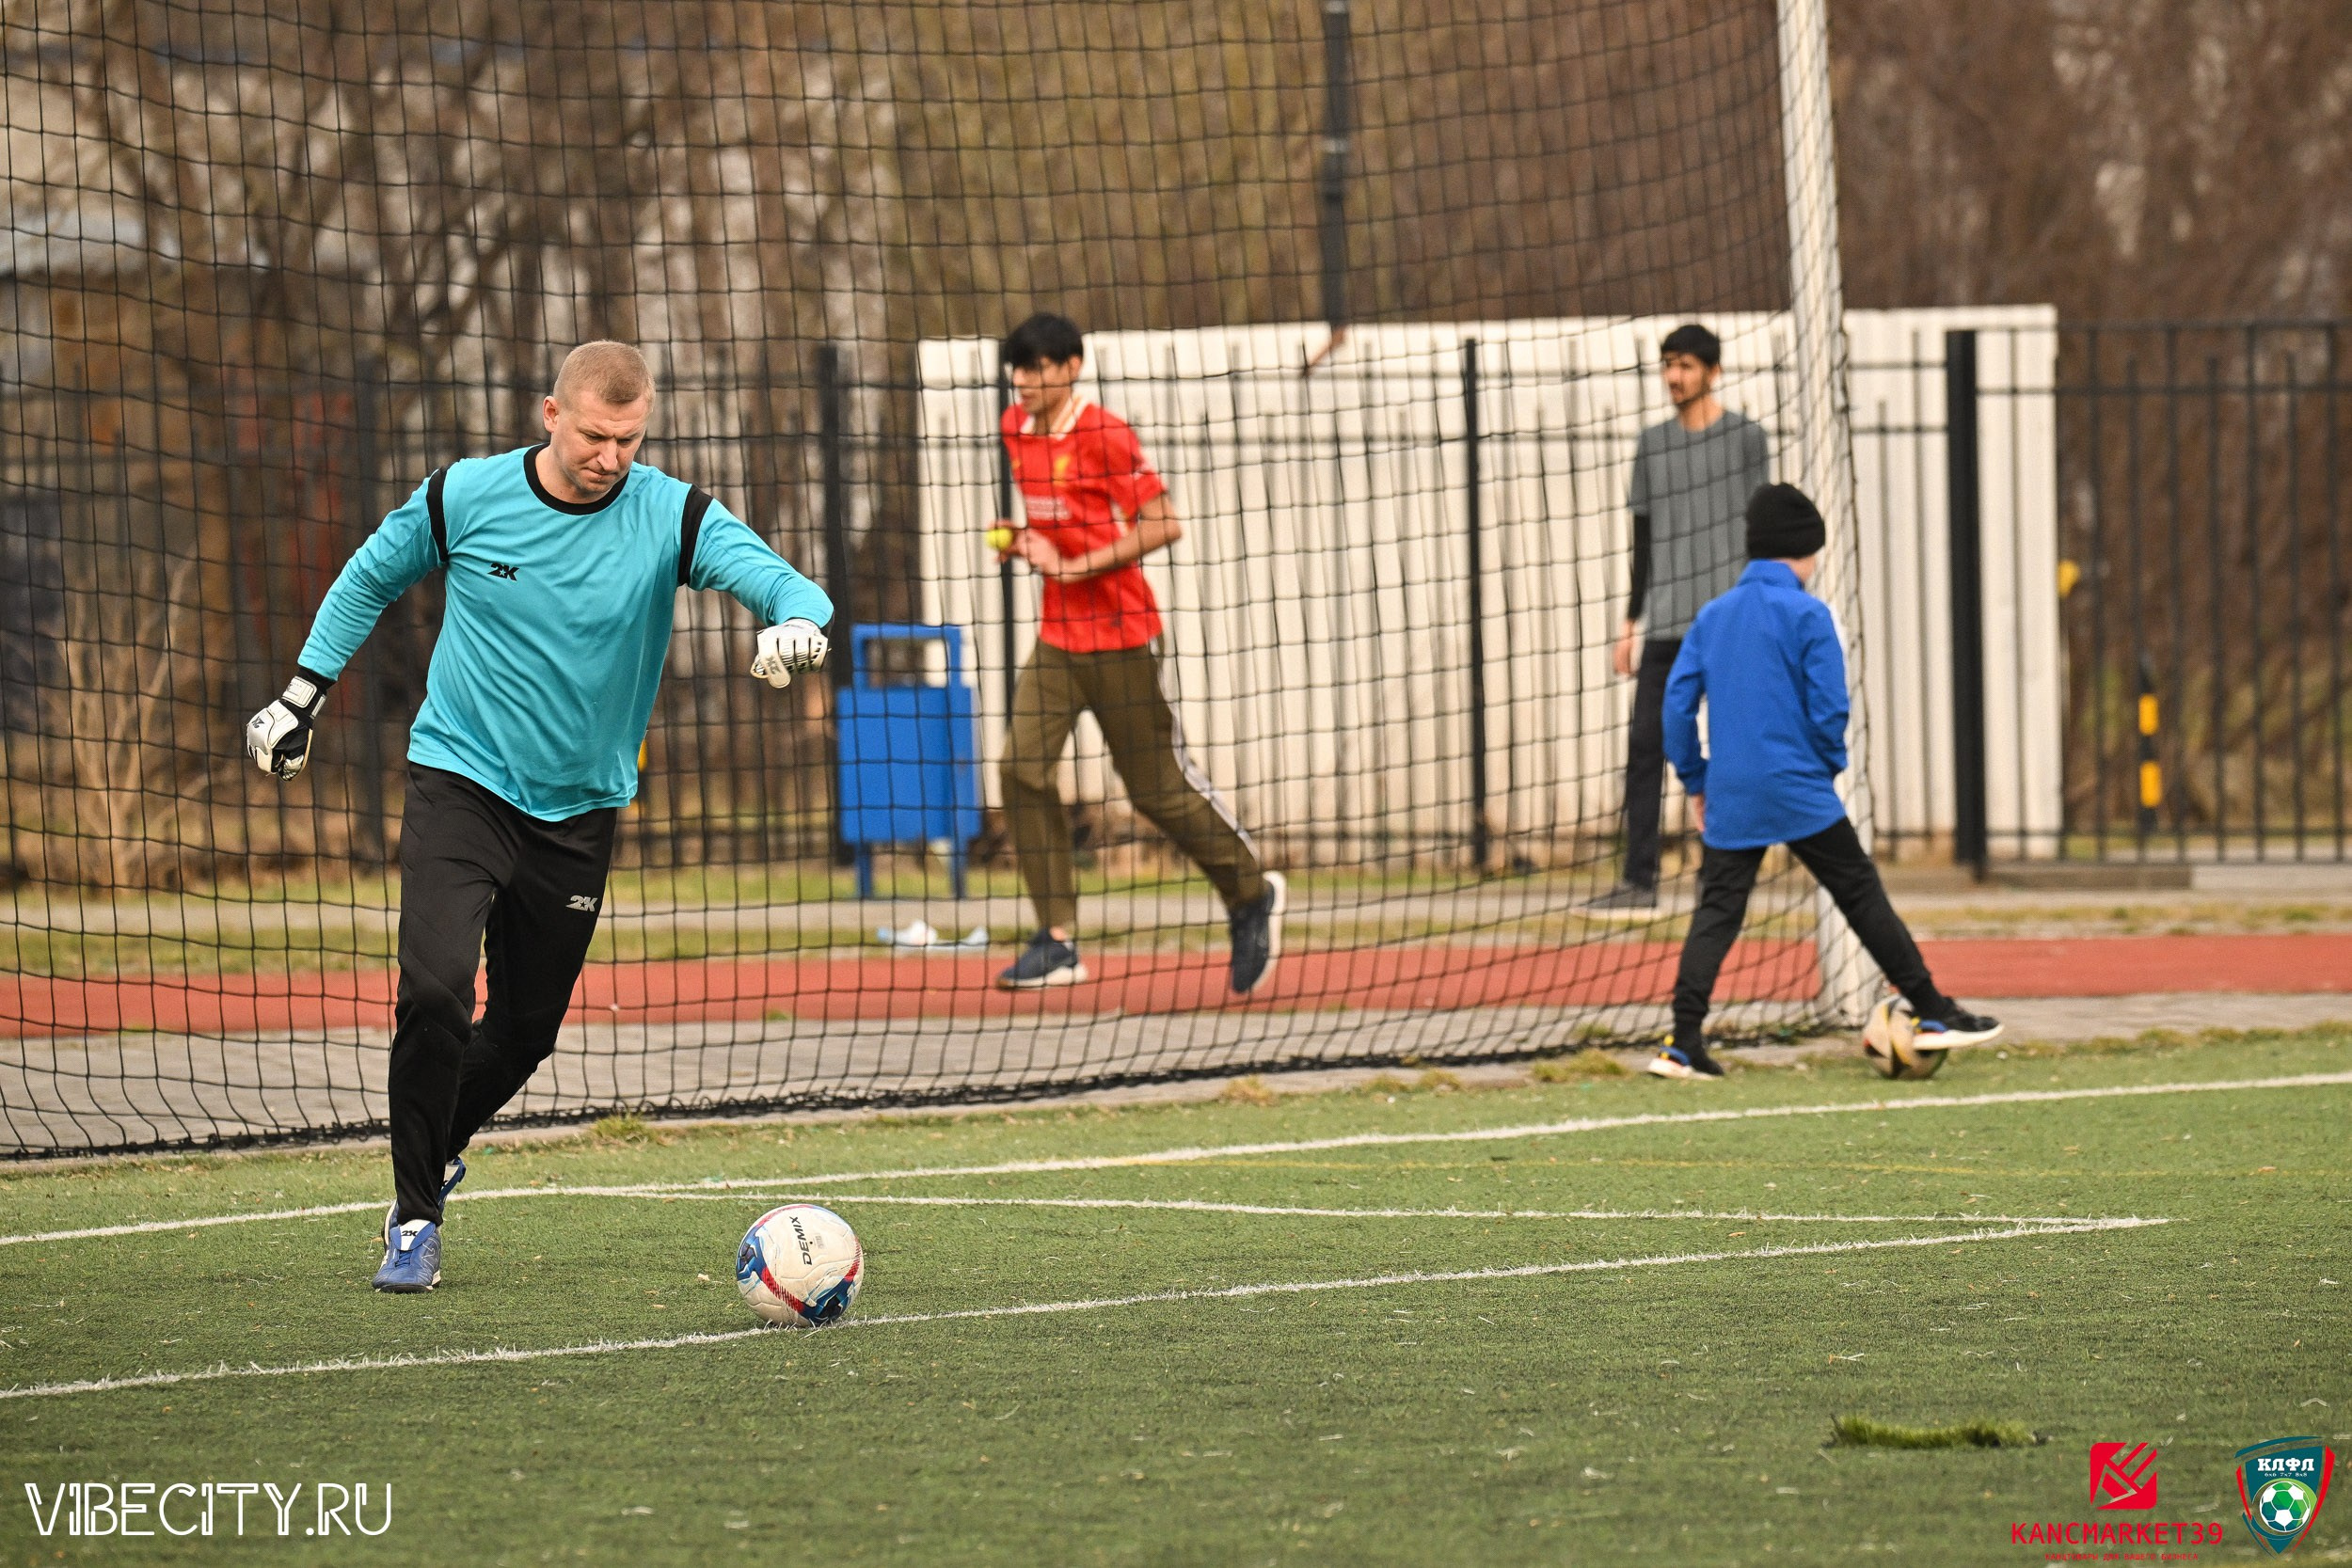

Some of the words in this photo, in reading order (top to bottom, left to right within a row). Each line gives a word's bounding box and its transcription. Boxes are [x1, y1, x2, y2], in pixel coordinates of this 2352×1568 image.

[487, 562, 520, 581] 2K
[565, 895, 598, 912] 2K
[788, 1214, 813, 1266] DEMIX
